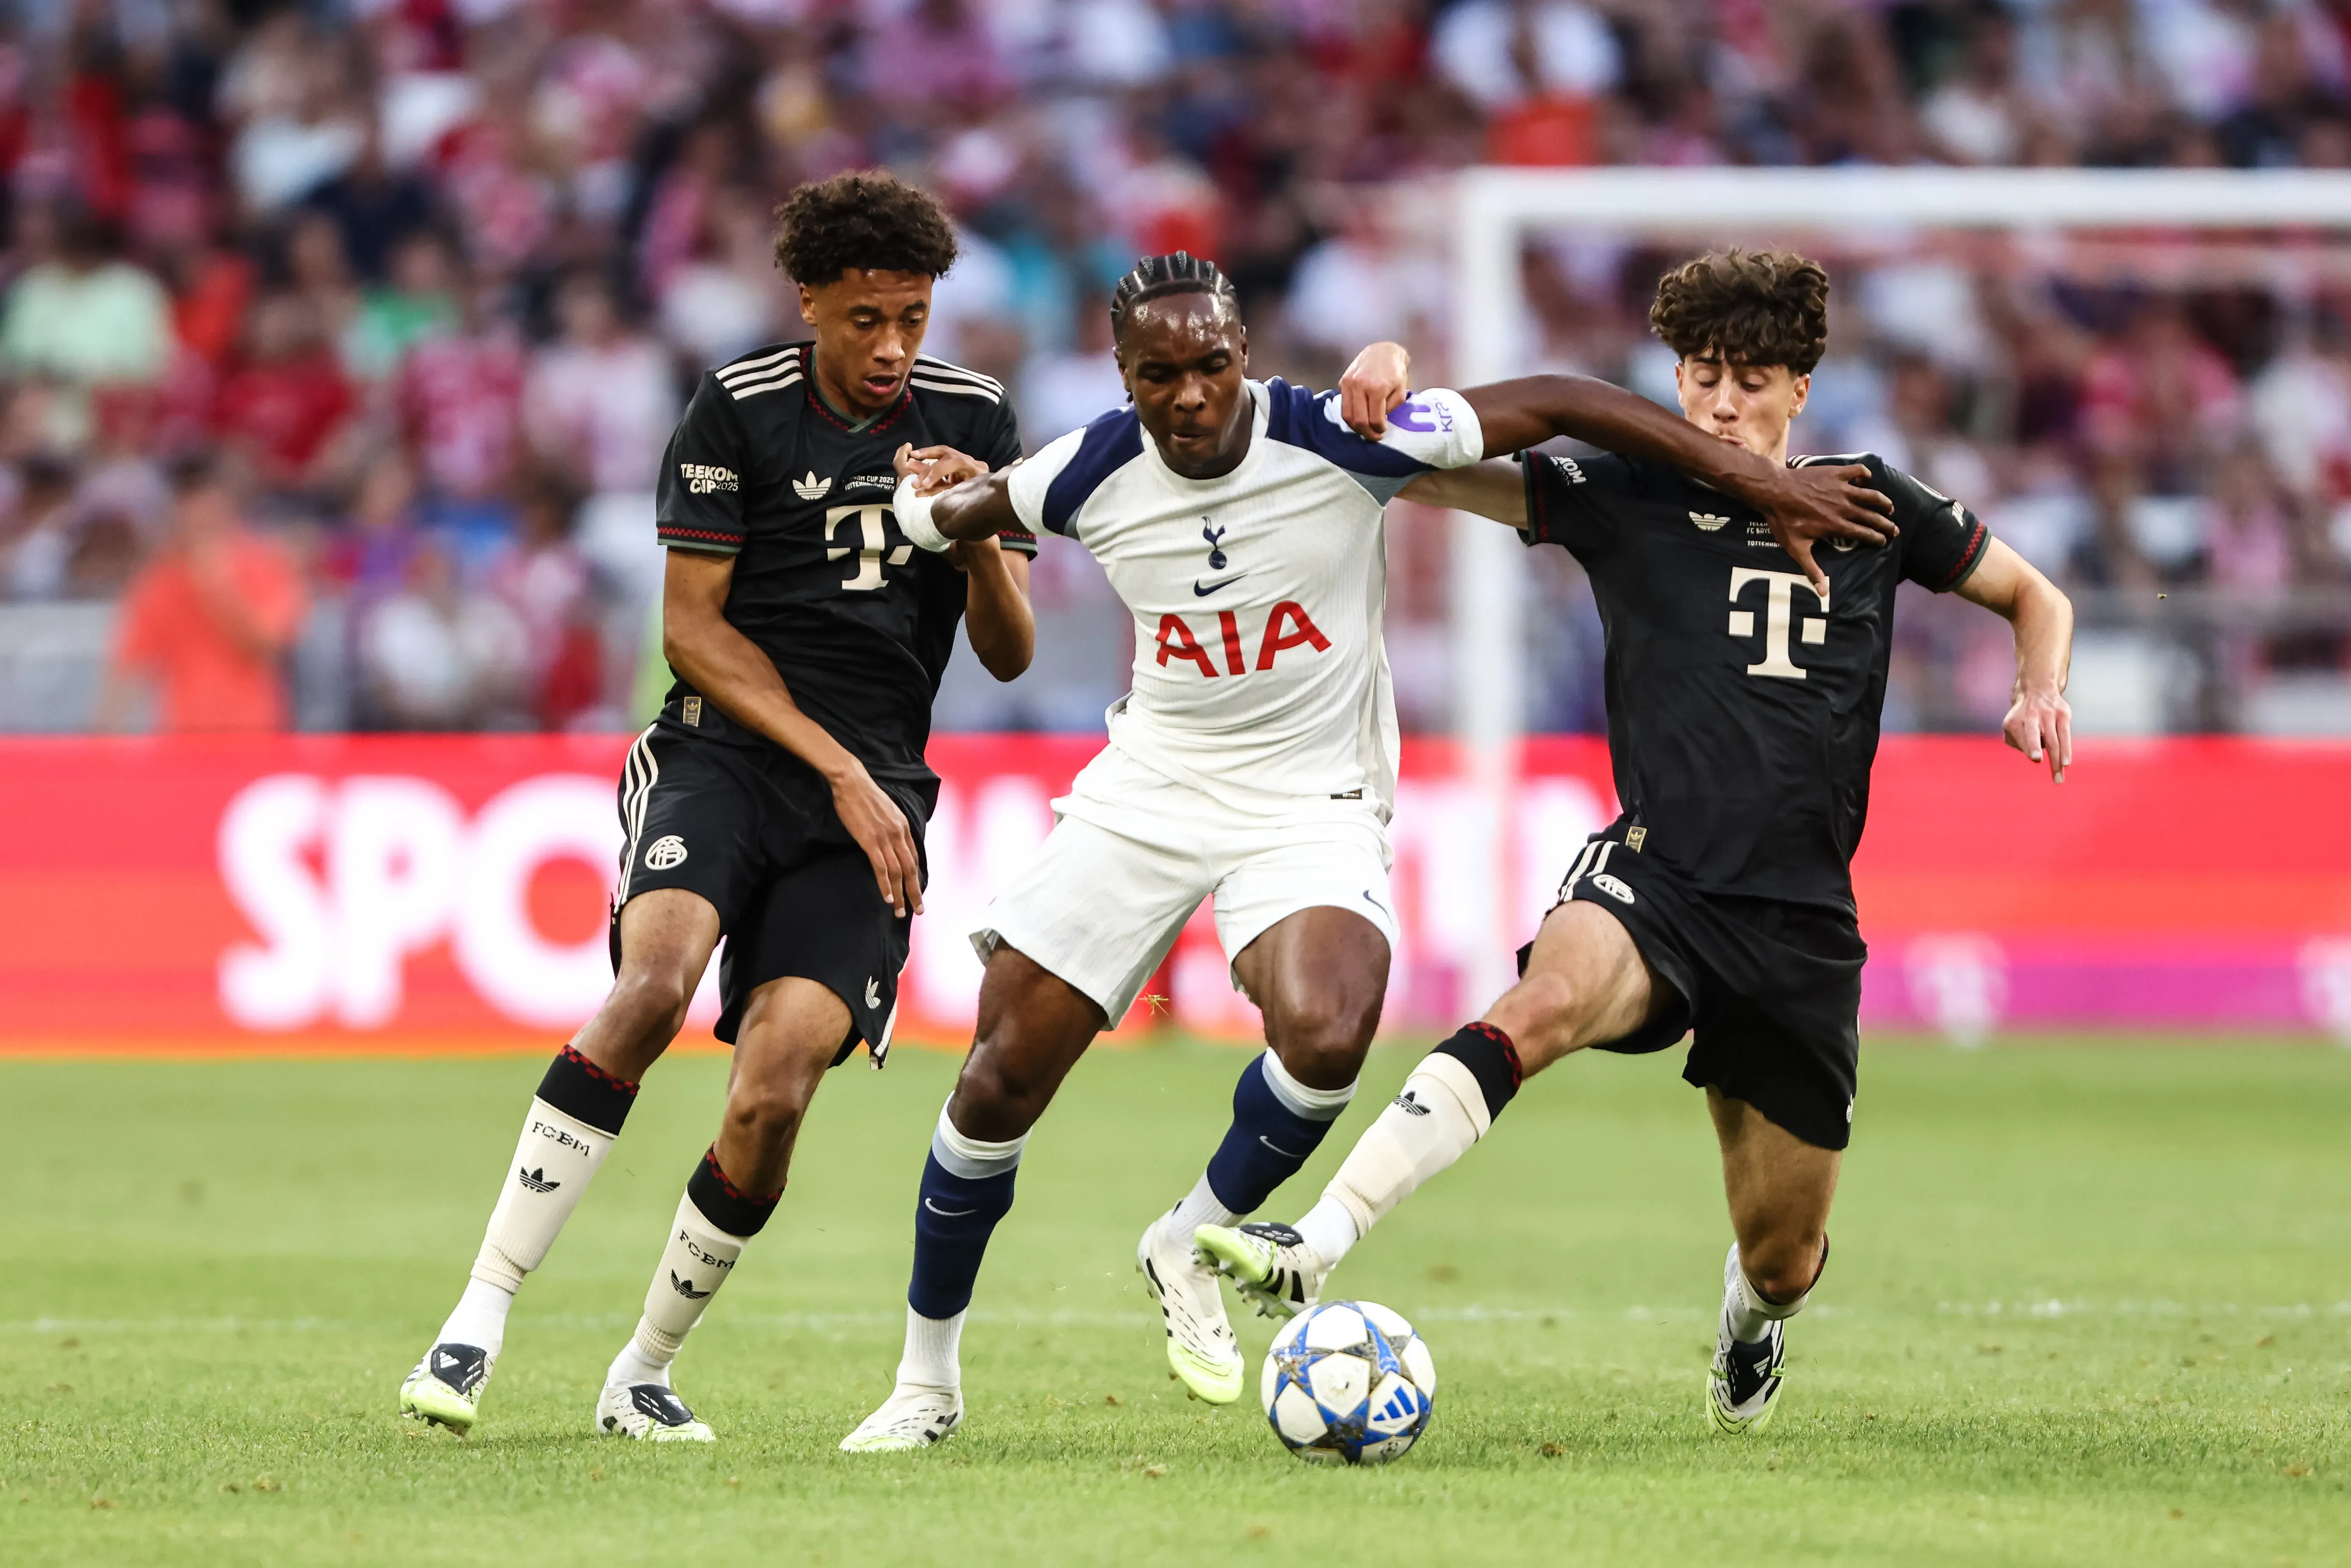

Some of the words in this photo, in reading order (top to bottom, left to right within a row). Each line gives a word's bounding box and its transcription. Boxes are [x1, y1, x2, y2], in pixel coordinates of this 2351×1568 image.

[690, 478, 717, 494] CUP
[716, 481, 739, 492] 2025
[826, 504, 913, 591] T
[1155, 600, 1333, 678] AIA
[1728, 566, 1830, 679] T
[532, 1121, 590, 1157] FCBM
[679, 1229, 736, 1269] FCBM
